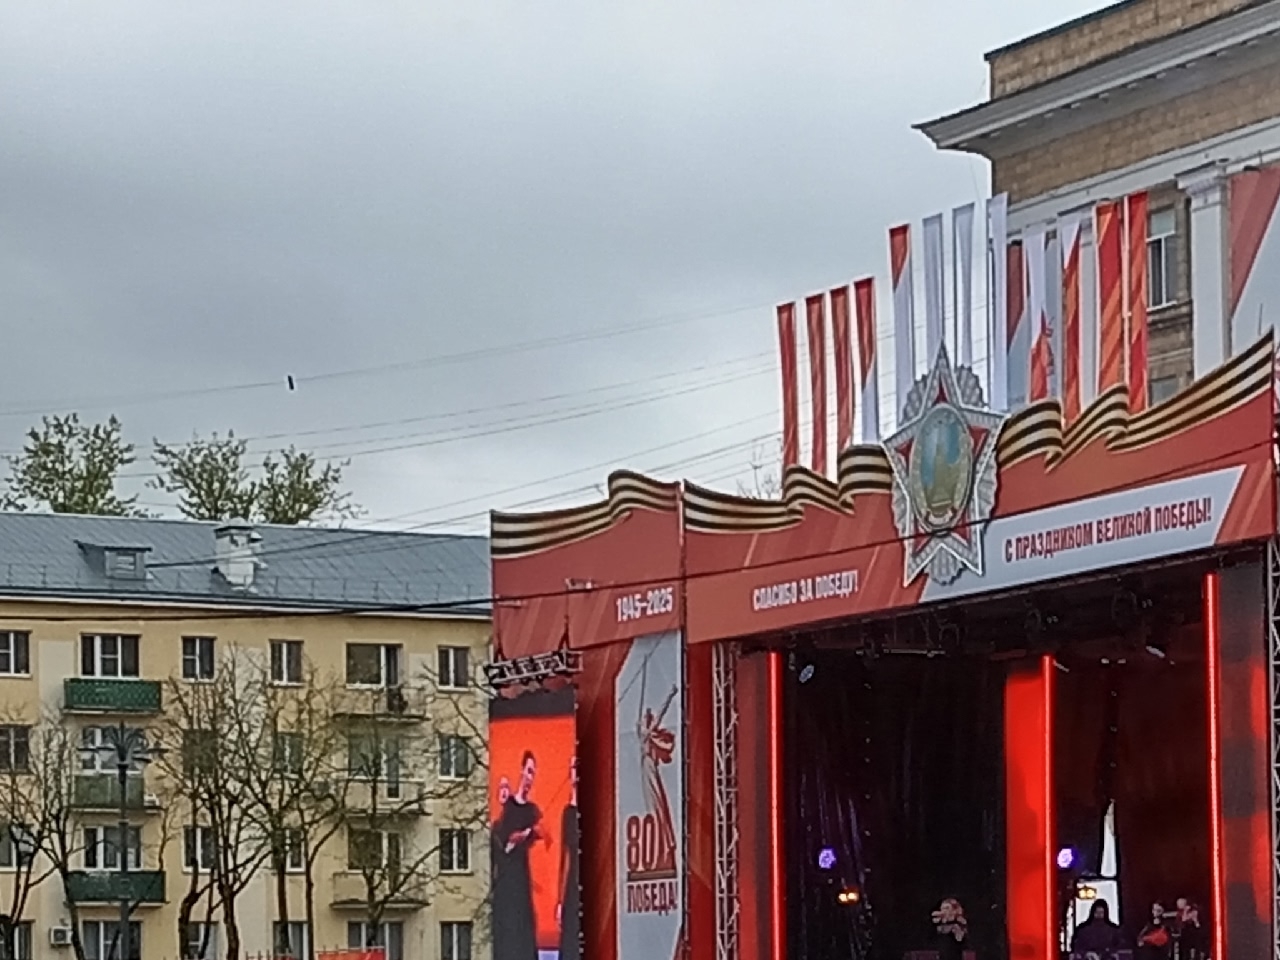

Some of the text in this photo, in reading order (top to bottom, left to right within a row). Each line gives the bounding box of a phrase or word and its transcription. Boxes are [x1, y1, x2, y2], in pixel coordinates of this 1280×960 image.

[1005, 497, 1212, 562] С ПРАЗДНИКОМ ВЕЛИКОЙ ПОБЕДЫ!
[616, 587, 673, 622] 1945-2025
[753, 569, 858, 611] СПАСИБО ЗА ПОБЕДУ!
[627, 814, 656, 872] 80
[627, 881, 678, 916] ПОБЕДА!
